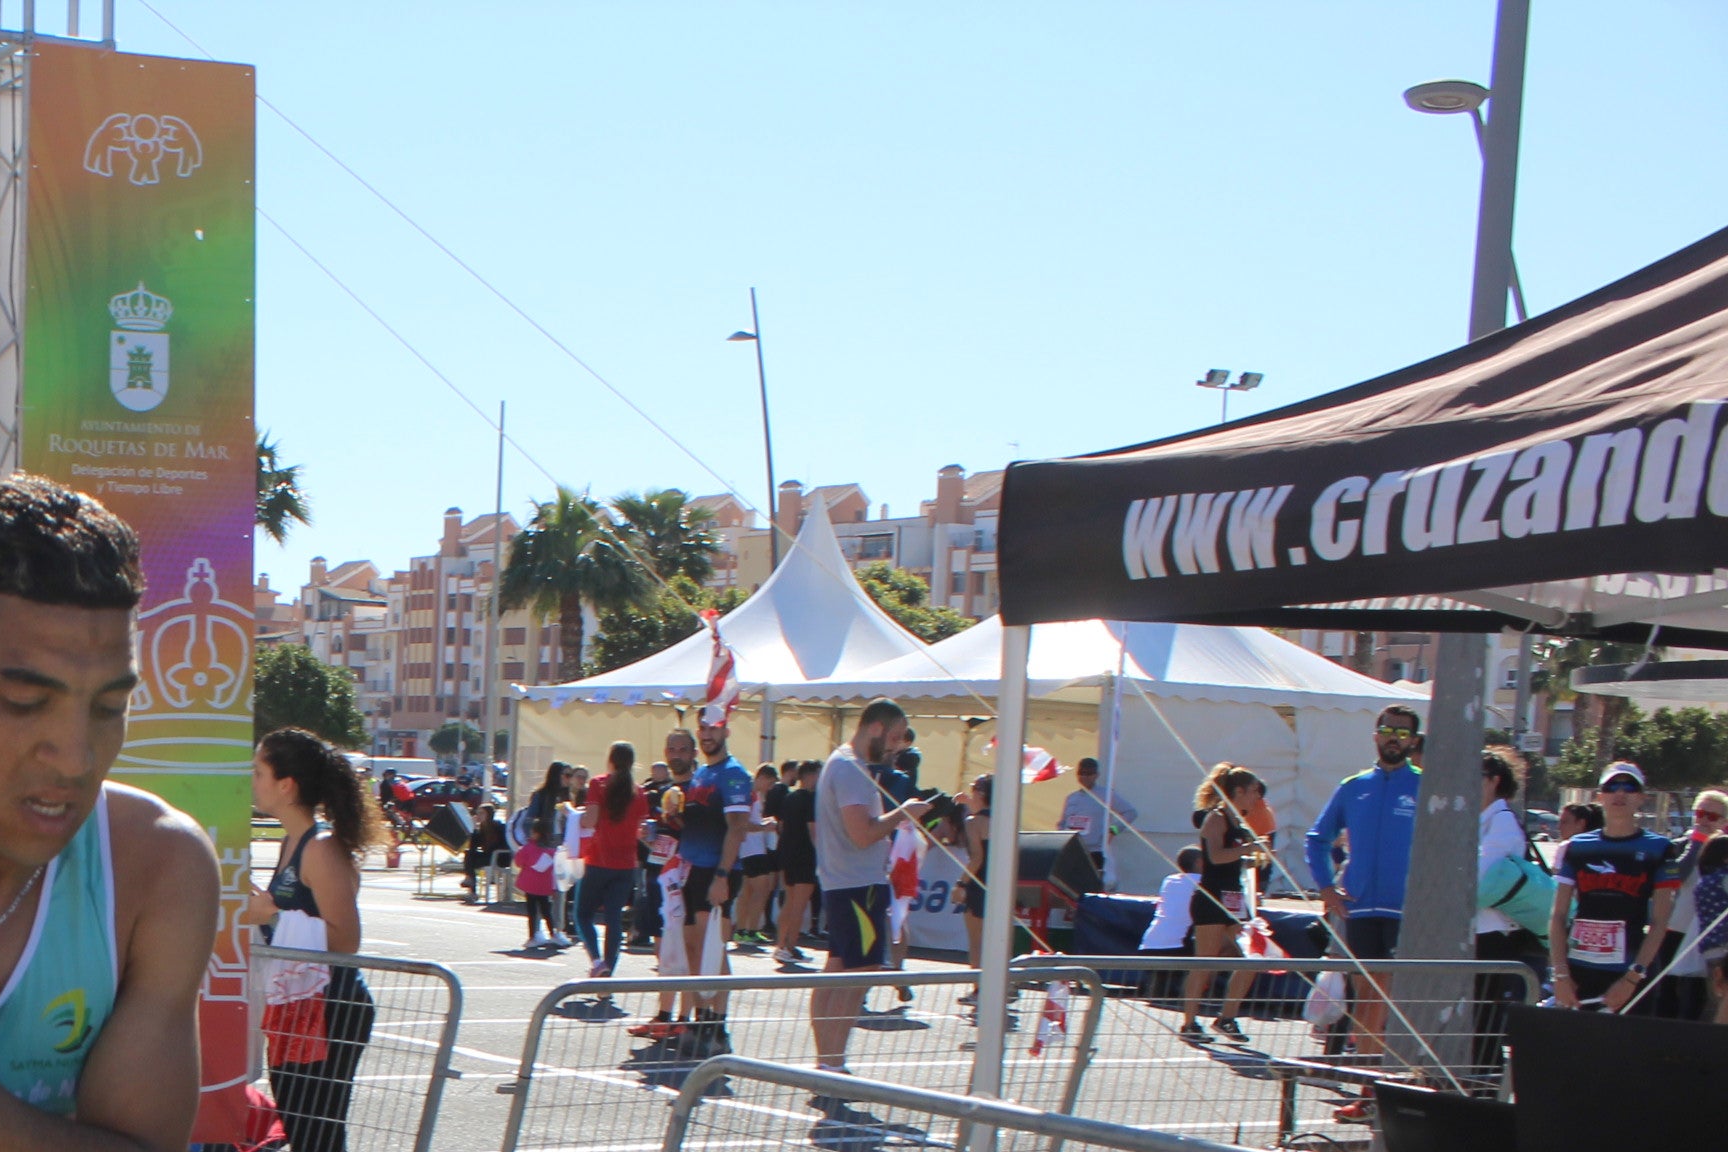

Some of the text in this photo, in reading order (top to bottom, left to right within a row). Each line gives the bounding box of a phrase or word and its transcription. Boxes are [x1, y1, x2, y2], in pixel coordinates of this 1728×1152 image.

[185, 425, 201, 436] DE
[49, 434, 230, 461] ROQUETAS DE MAR
[72, 464, 209, 481] Delegación de Deportes
[108, 481, 150, 495] Tiempo
[153, 483, 184, 495] Libre
